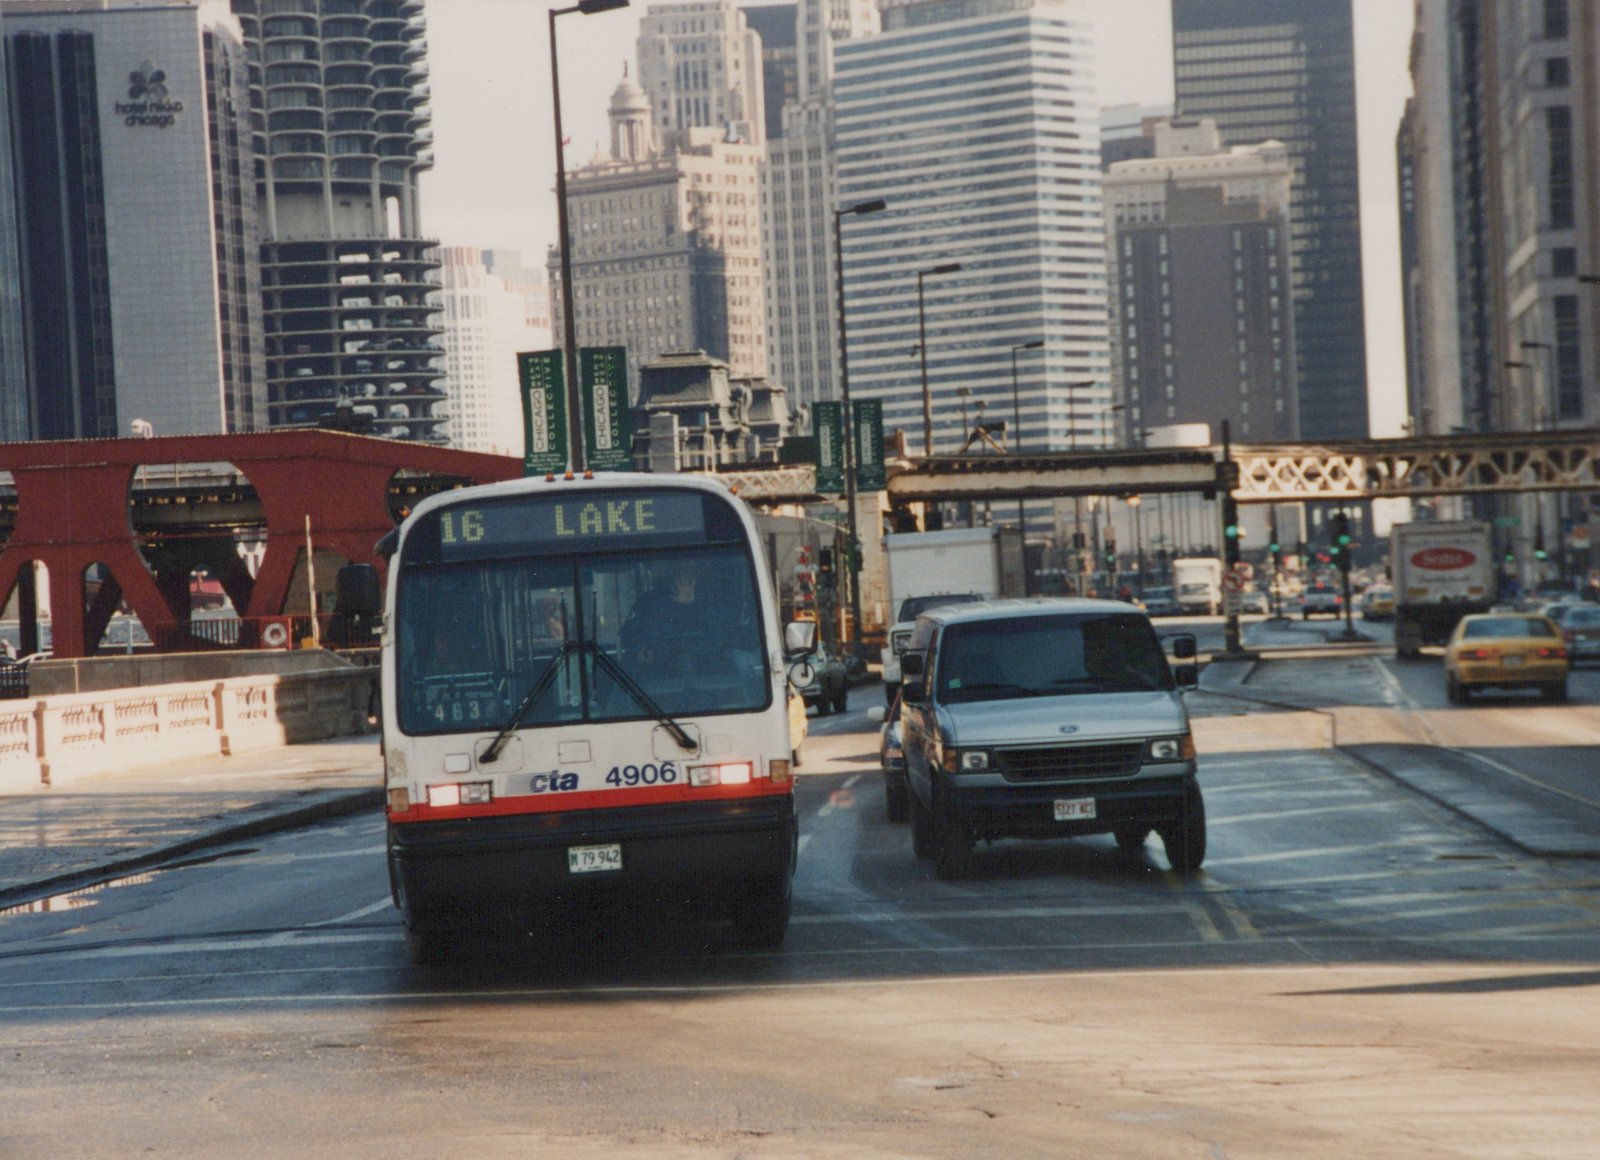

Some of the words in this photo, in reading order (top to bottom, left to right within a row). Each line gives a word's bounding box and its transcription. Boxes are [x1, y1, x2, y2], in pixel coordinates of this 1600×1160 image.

[114, 101, 147, 114] hotel
[125, 114, 175, 129] chicago
[533, 390, 545, 451] CHICAGO
[543, 357, 556, 451] COLLECTIVE
[595, 387, 608, 448] CHICAGO
[441, 510, 484, 543] 16
[555, 500, 655, 536] LAKE
[530, 769, 579, 793] cta
[605, 762, 677, 787] 4906
[581, 851, 595, 865] 79
[598, 849, 620, 864] 942
